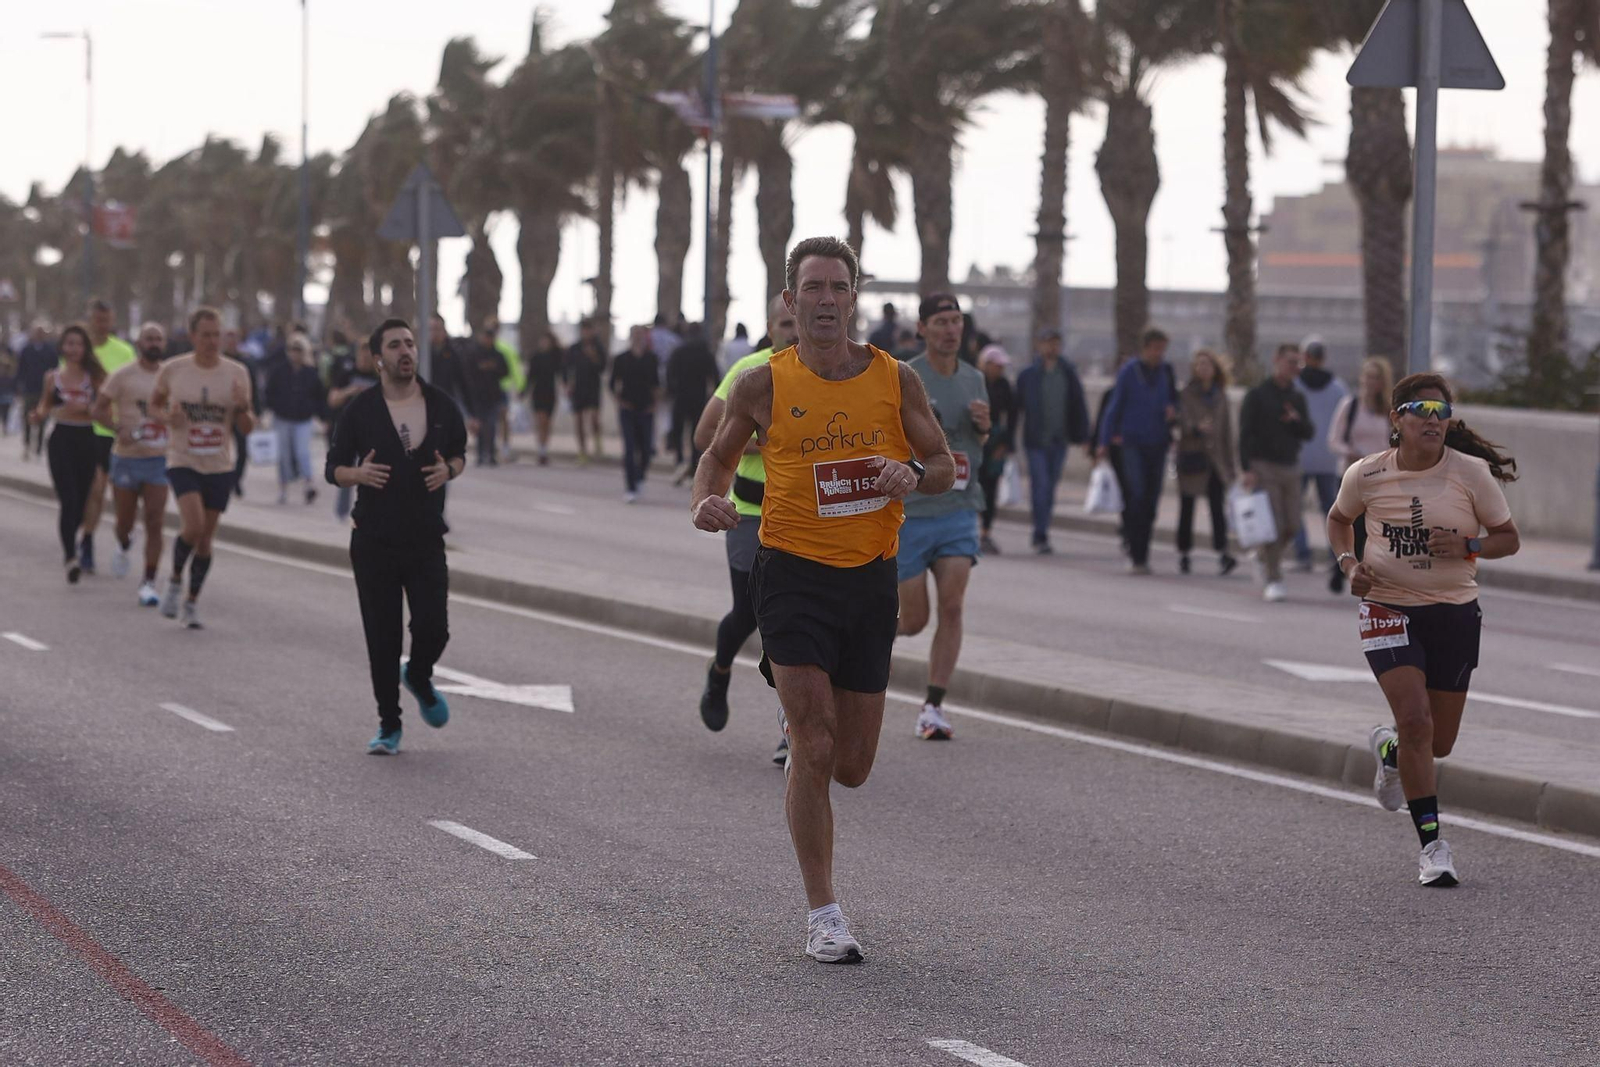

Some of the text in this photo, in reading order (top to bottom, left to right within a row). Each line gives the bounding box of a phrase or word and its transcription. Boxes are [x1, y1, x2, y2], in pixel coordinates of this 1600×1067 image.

[801, 417, 885, 458] parkrun
[819, 479, 851, 489] BRUNCH
[823, 487, 840, 496] RUN
[1381, 521, 1458, 542] BRUN
[1389, 540, 1429, 559] RUN
